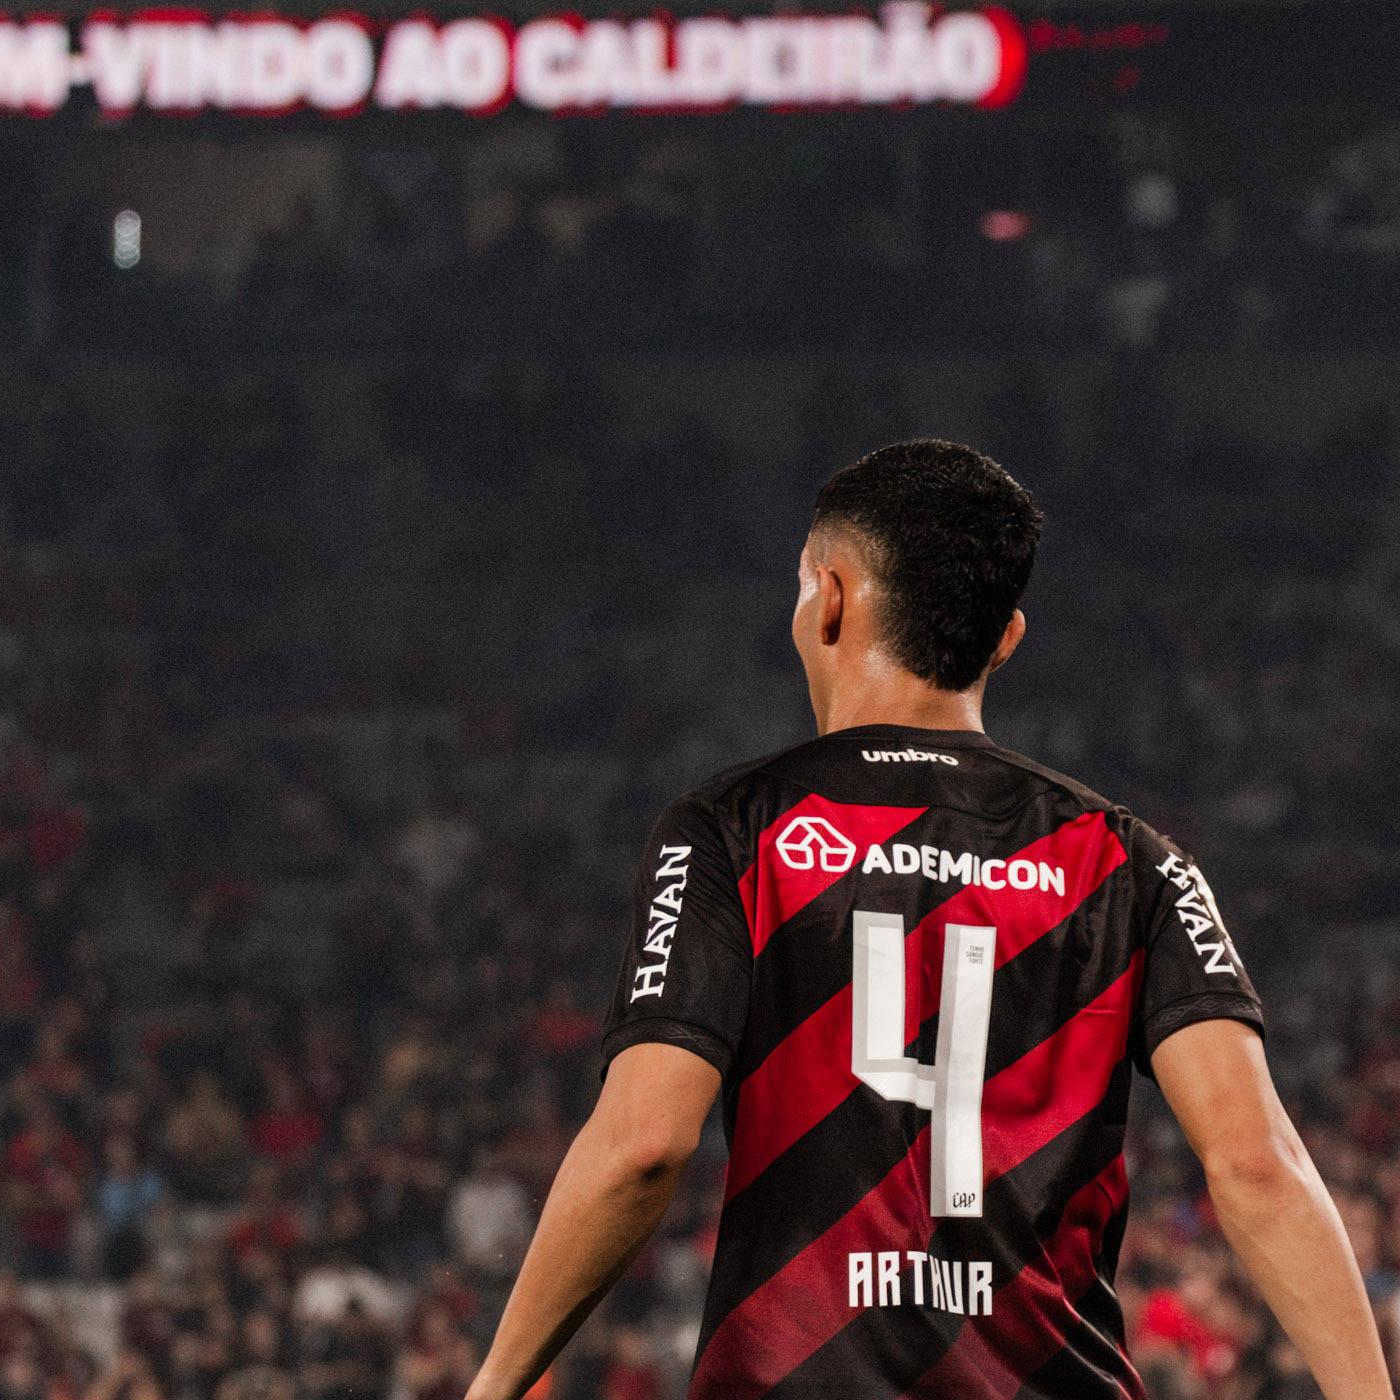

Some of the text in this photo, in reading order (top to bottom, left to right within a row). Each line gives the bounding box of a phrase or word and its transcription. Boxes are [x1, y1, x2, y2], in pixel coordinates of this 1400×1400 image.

[375, 18, 510, 107] AO
[512, 5, 1002, 107] CALDEIRÃO
[861, 749, 959, 766] umbro
[862, 844, 1065, 897] ADEMICON
[629, 845, 692, 1004] HAVAN
[851, 910, 997, 1218] 4
[849, 1251, 992, 1316] ARTHUR
